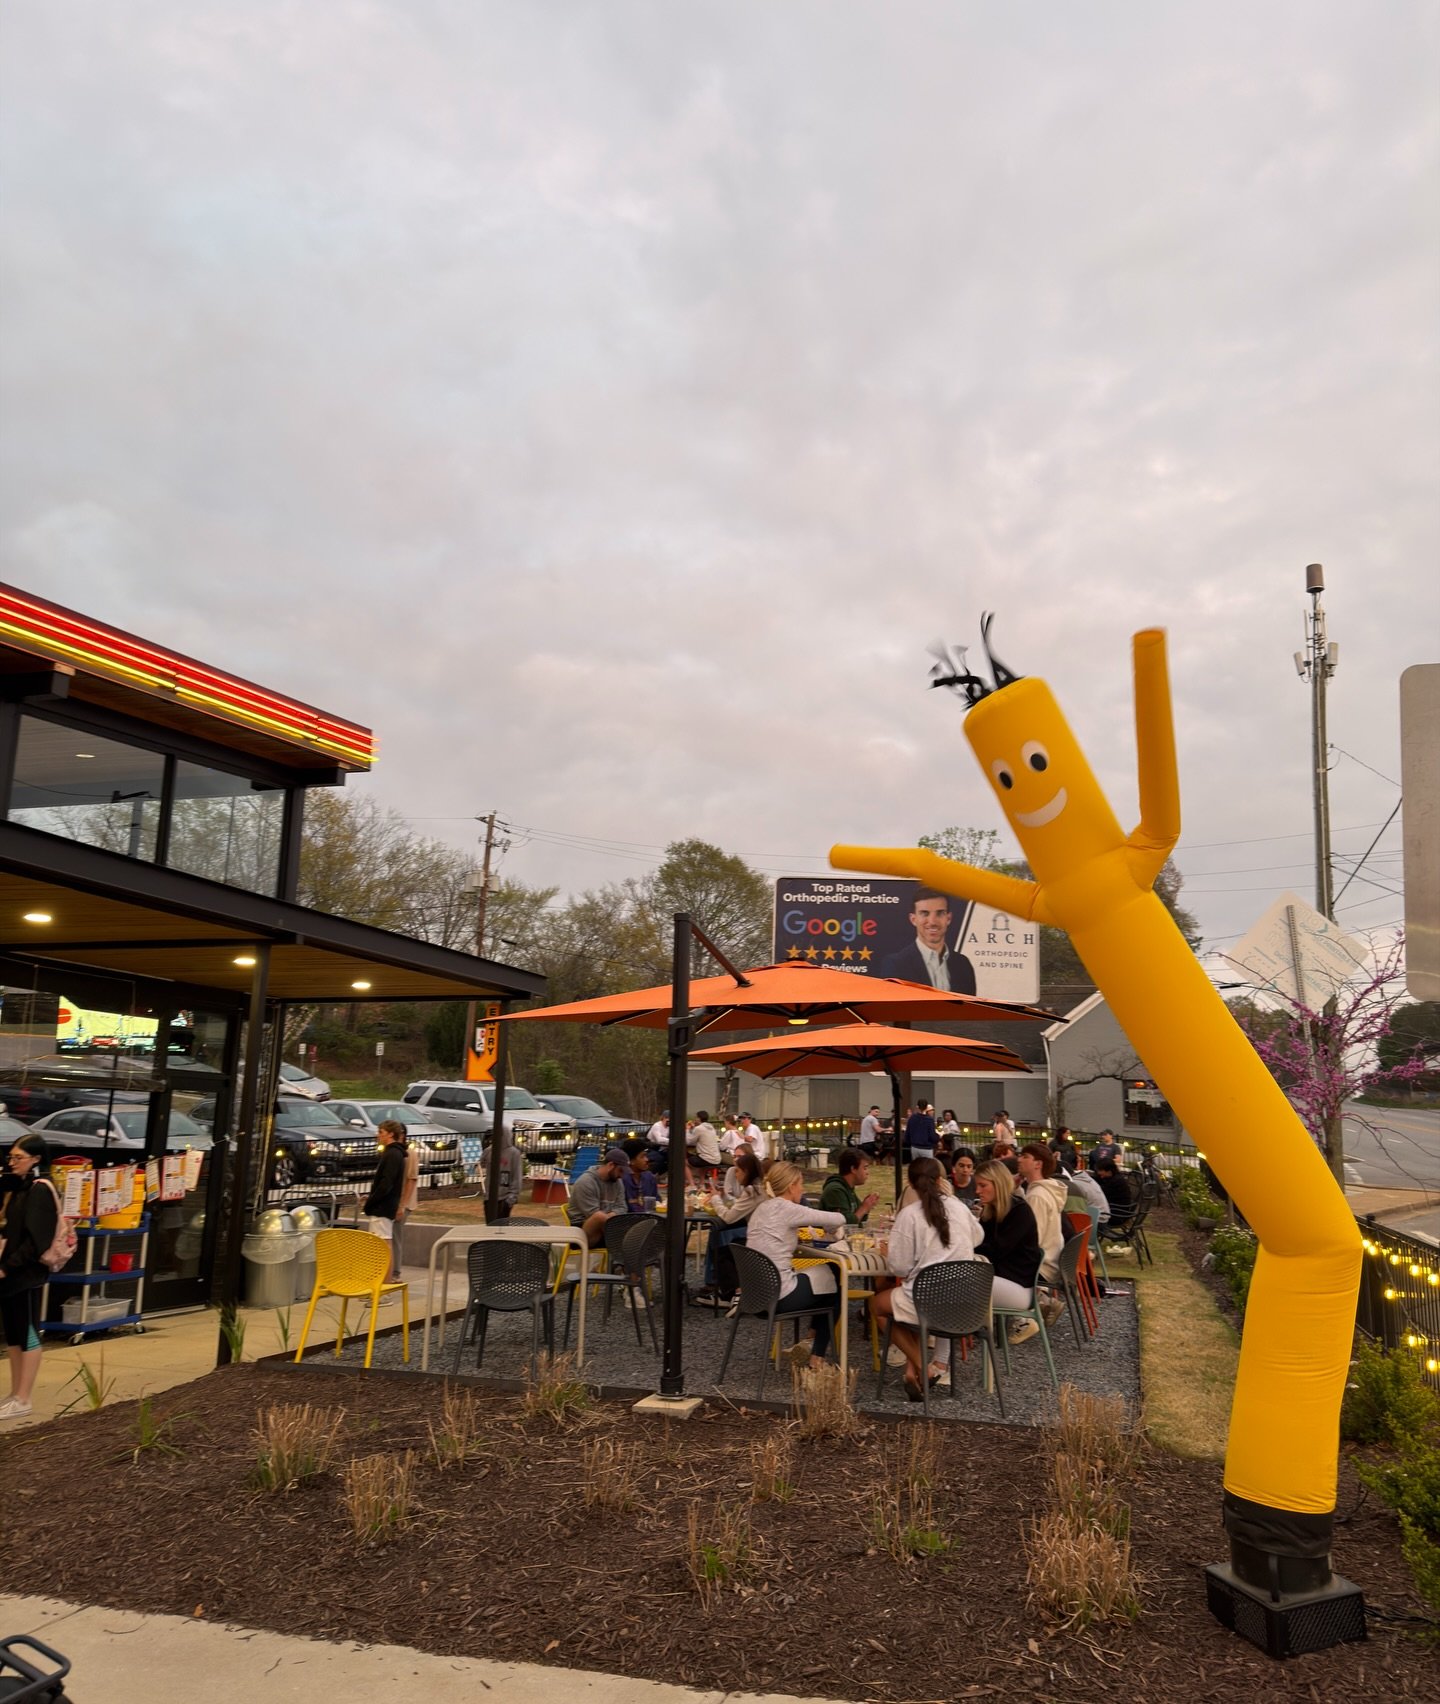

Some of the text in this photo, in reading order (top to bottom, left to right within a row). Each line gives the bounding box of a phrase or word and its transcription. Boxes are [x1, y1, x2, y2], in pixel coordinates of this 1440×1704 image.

[811, 883, 870, 894] Top Rated
[783, 893, 900, 904] Orthopedic Practice
[783, 910, 878, 942] Google
[968, 932, 1034, 945] ARCH
[974, 950, 1029, 958] ORTHOPEDIC
